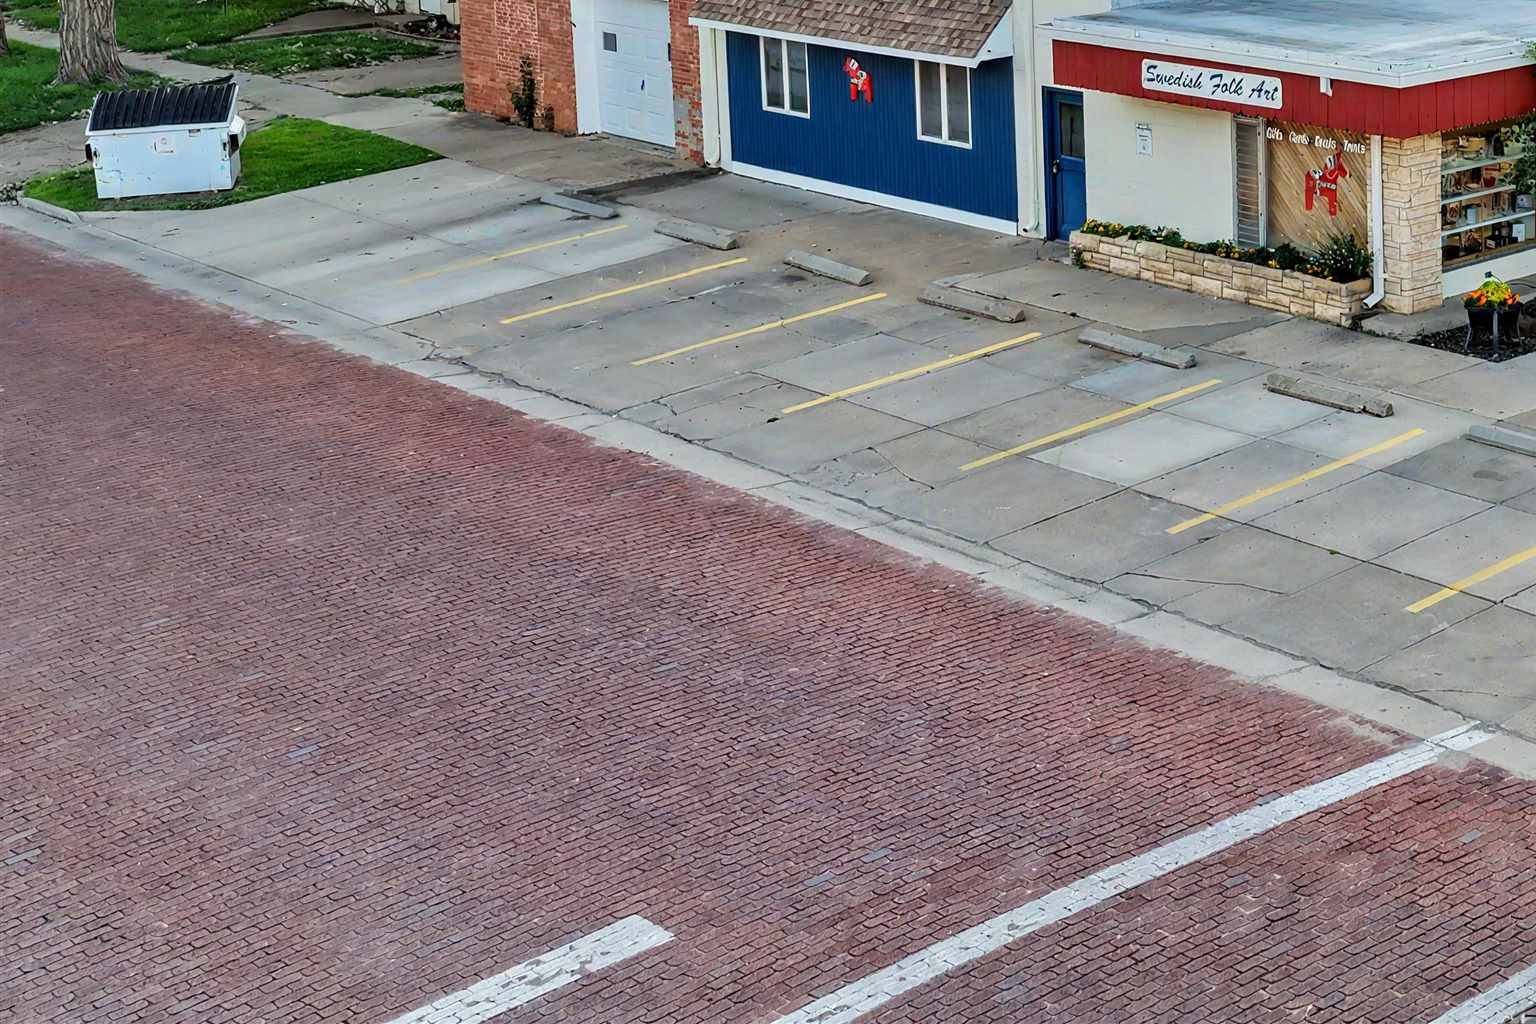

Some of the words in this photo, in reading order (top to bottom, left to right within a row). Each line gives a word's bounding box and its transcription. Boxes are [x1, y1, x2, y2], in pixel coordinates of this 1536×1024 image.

[1146, 64, 1203, 90] Swedish
[1209, 73, 1244, 96] Folk
[1249, 79, 1278, 102] Art
